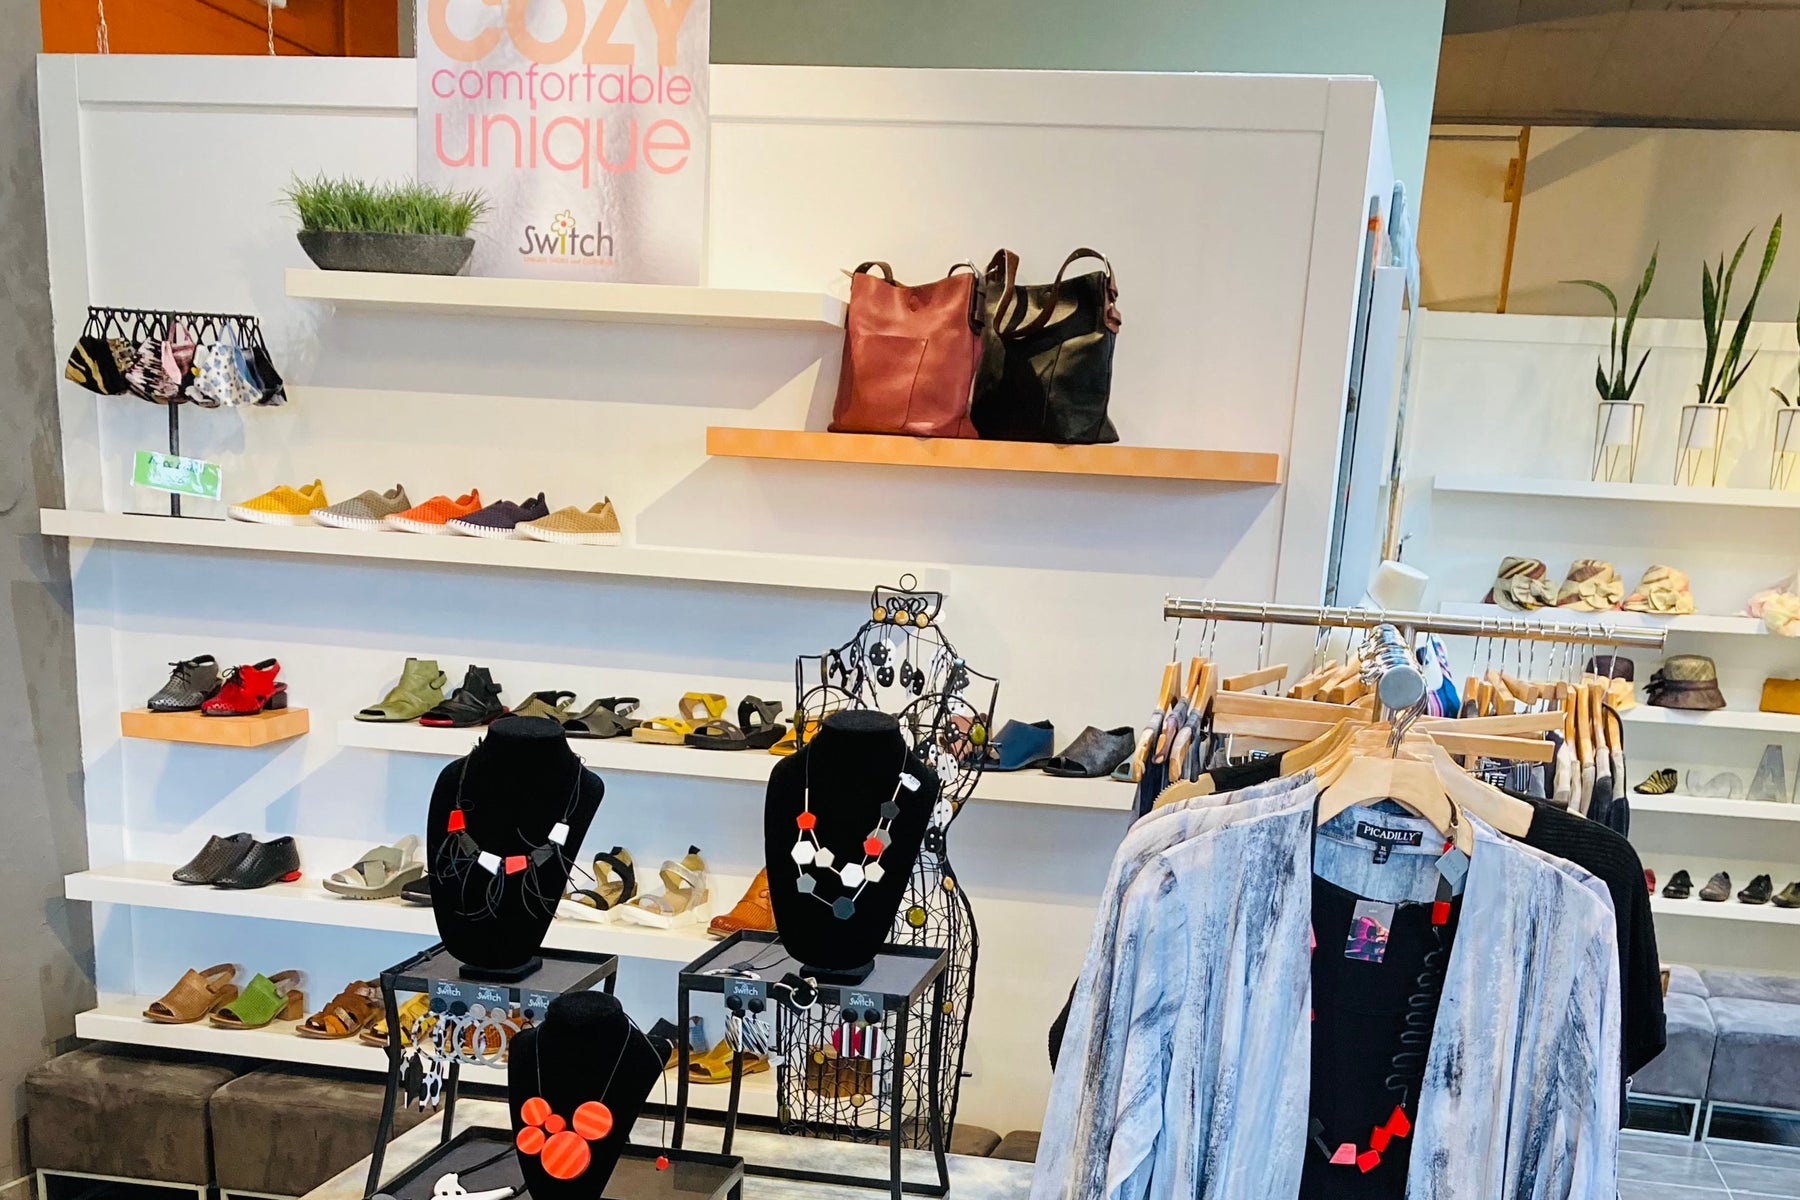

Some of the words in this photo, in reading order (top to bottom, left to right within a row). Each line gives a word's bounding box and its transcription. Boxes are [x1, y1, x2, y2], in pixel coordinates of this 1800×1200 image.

[427, 0, 694, 66] COZY
[431, 62, 692, 105] comfortable
[434, 100, 691, 189] unique
[519, 213, 613, 257] Switch
[1364, 825, 1421, 841] PICADILLY
[436, 986, 461, 997] Switch
[476, 990, 502, 1003] Switch
[733, 985, 758, 996] Switch
[849, 996, 875, 1007] Switch
